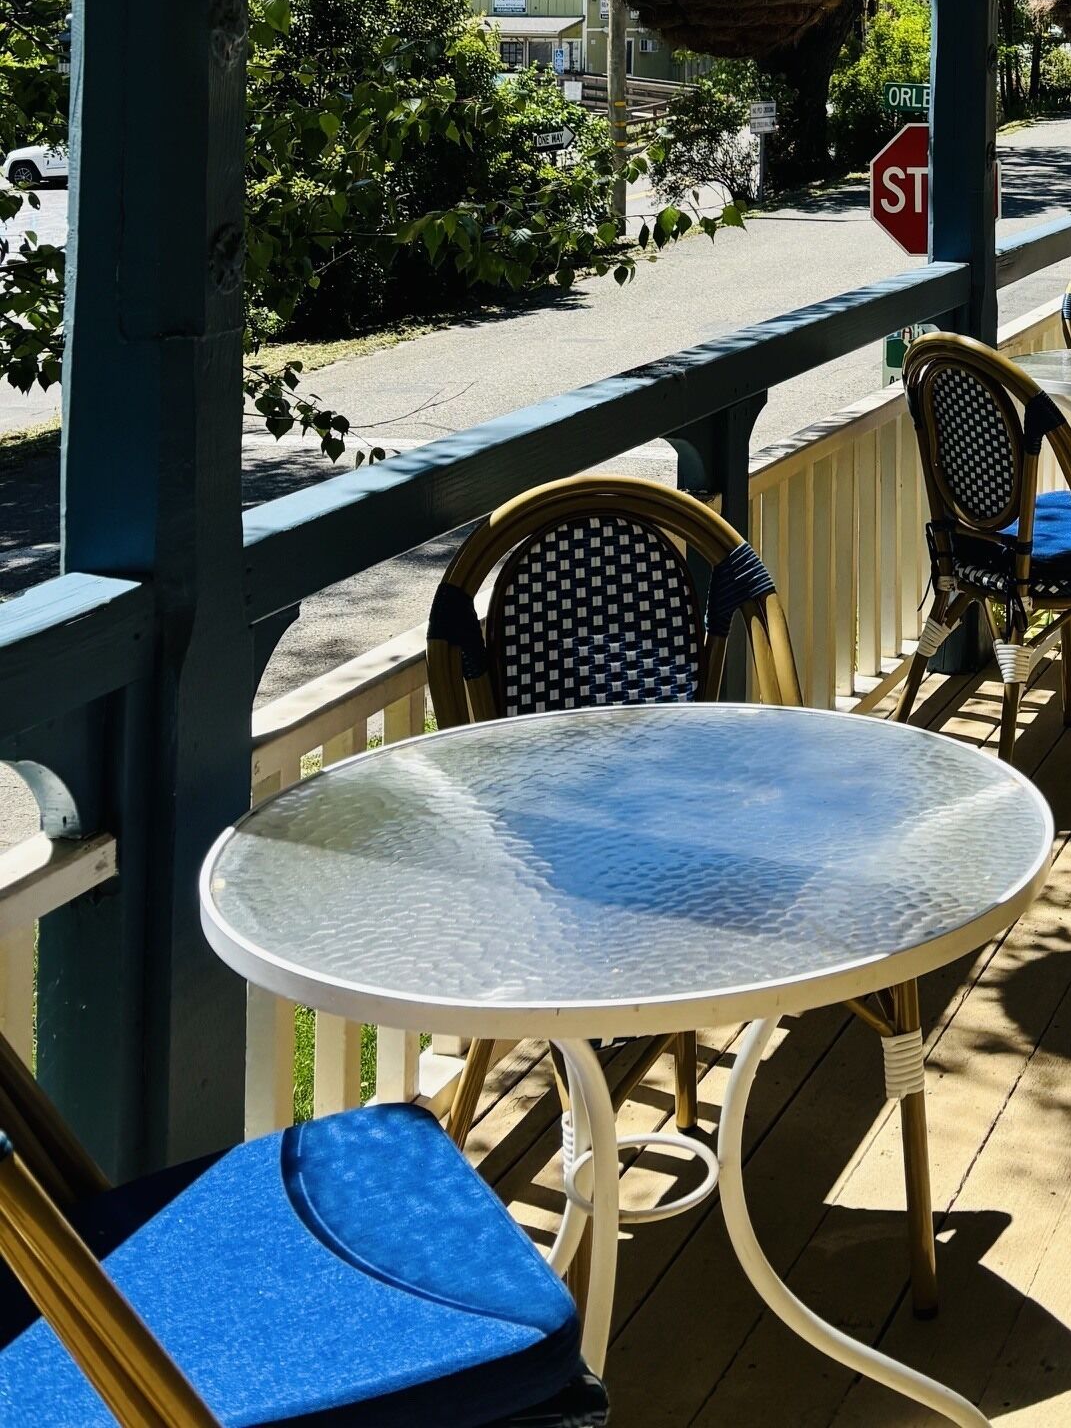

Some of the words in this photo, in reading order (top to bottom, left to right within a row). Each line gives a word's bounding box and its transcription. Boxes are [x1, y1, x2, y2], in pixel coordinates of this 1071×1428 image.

[888, 86, 931, 108] ORLE
[551, 132, 564, 143] WAY
[880, 166, 928, 214] ST
